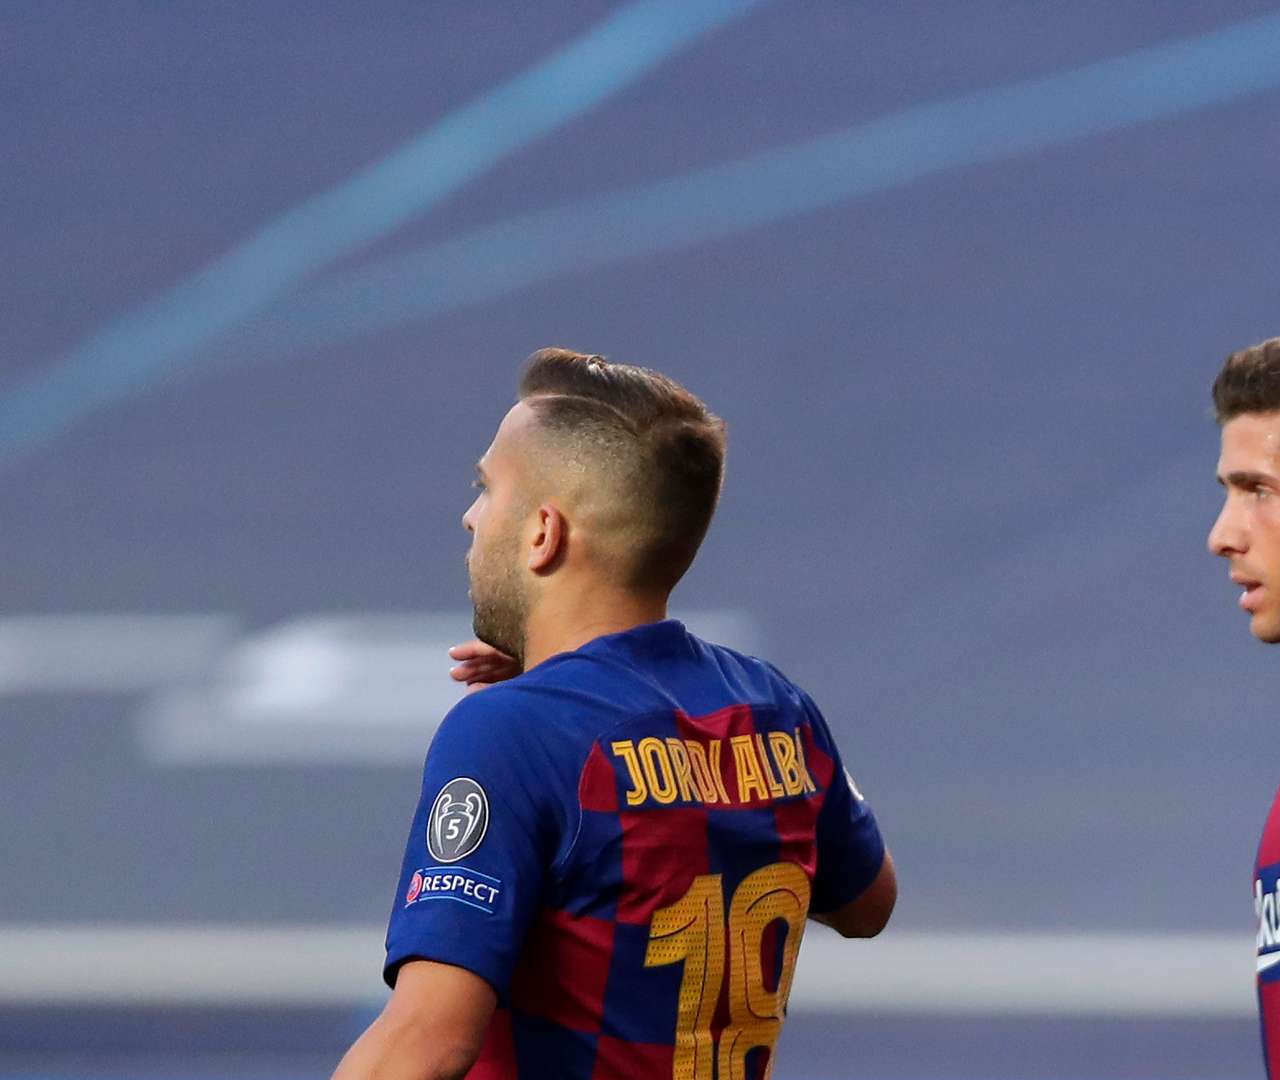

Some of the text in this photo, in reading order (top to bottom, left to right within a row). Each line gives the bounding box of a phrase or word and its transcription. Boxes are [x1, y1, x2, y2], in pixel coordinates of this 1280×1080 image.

[611, 737, 731, 806] JORDI
[445, 818, 462, 840] 5
[421, 874, 500, 905] RESPECT
